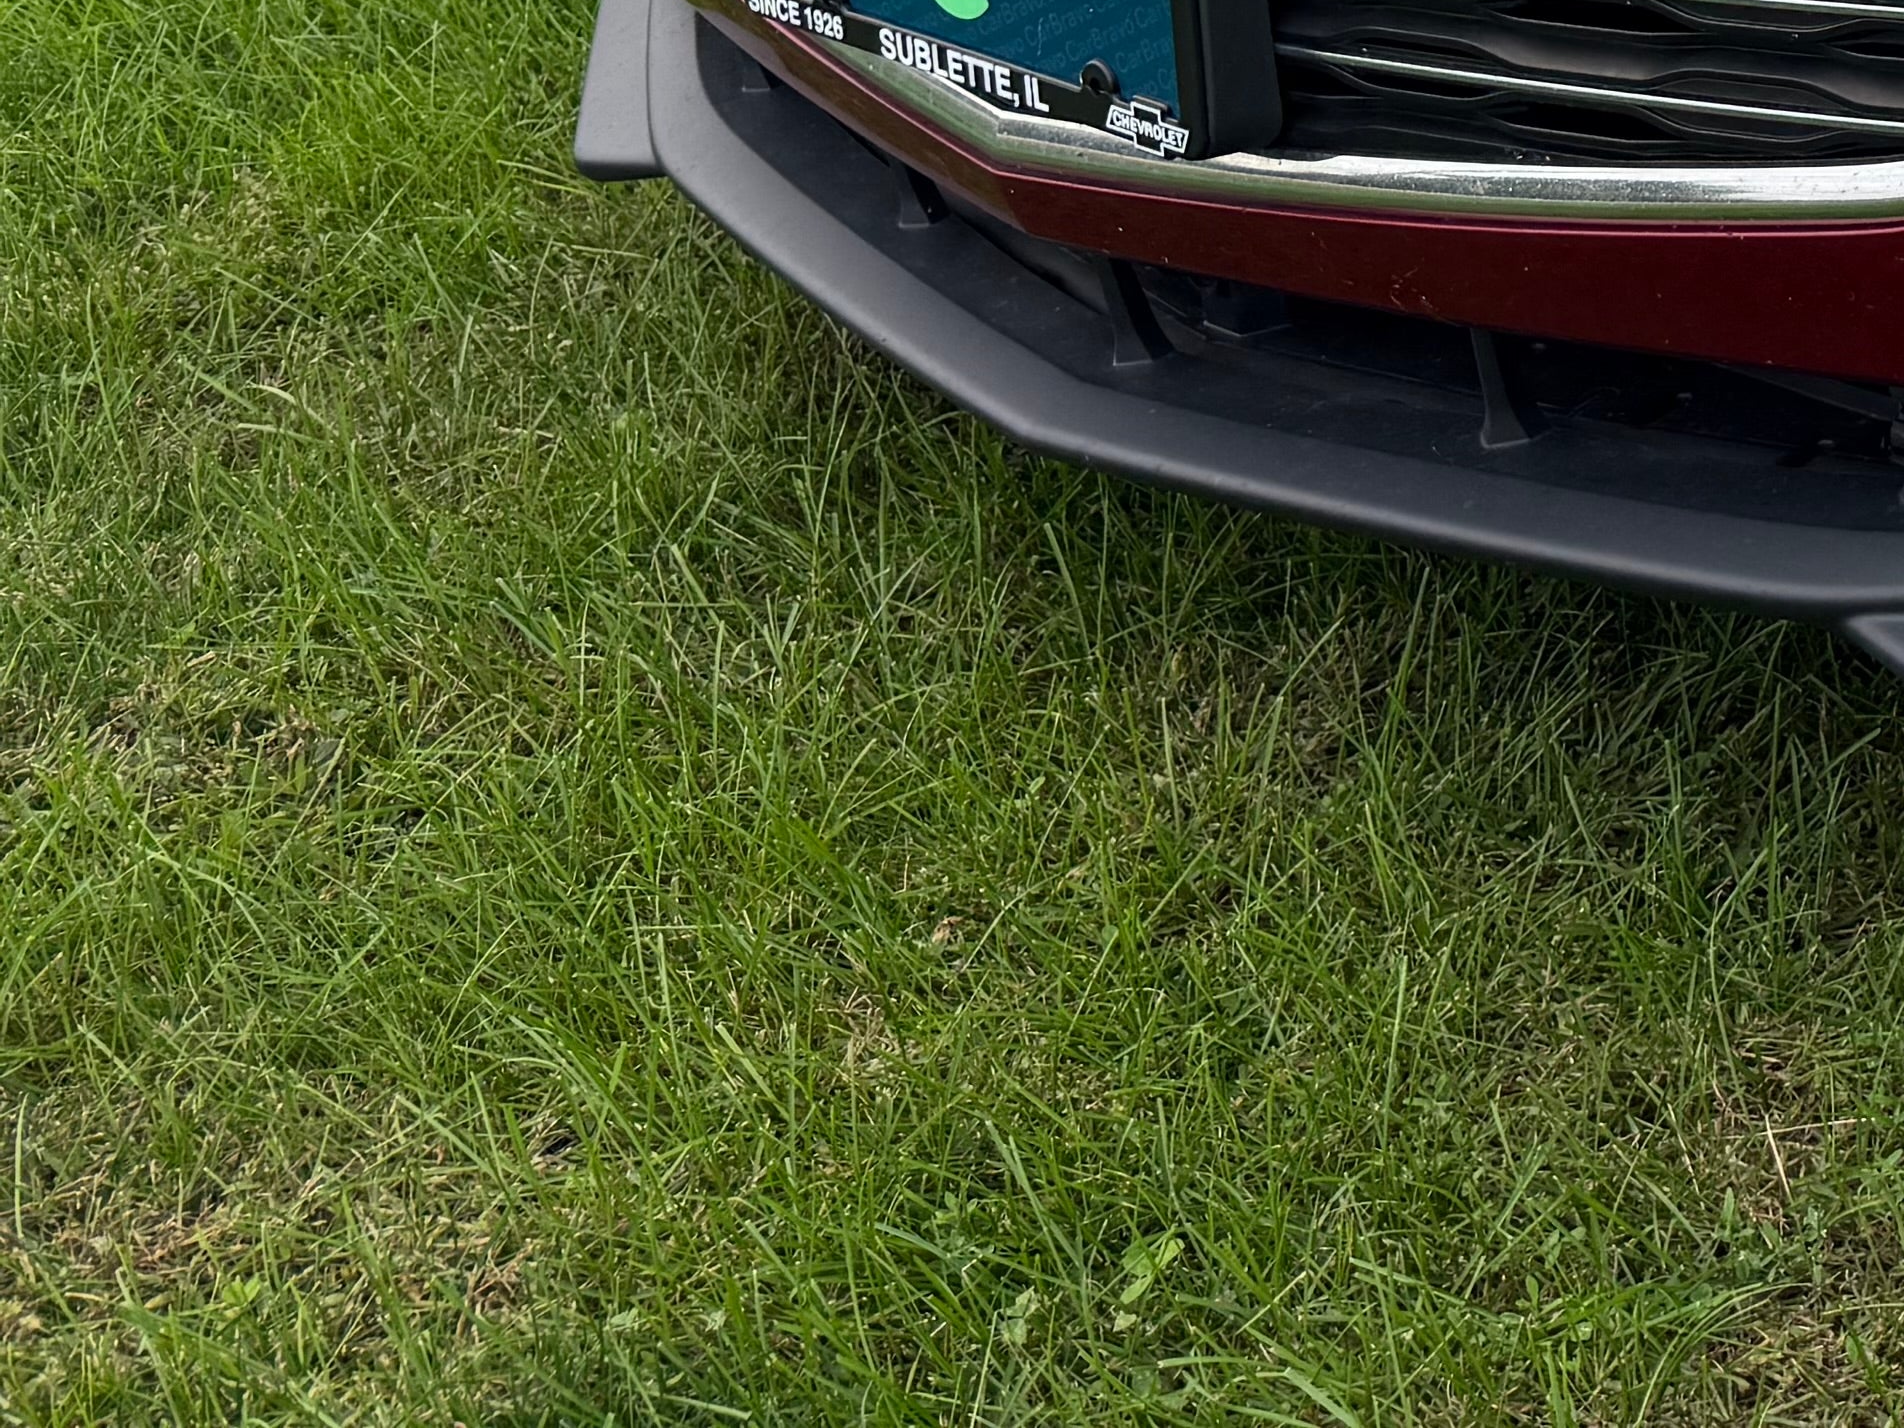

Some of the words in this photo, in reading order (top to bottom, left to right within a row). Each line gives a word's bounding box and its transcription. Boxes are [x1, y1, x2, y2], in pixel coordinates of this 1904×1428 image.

[804, 5, 845, 41] 1926
[879, 28, 1022, 108] SUBLETTE,
[1024, 75, 1050, 113] IL
[1112, 110, 1184, 148] CHEVROLET
